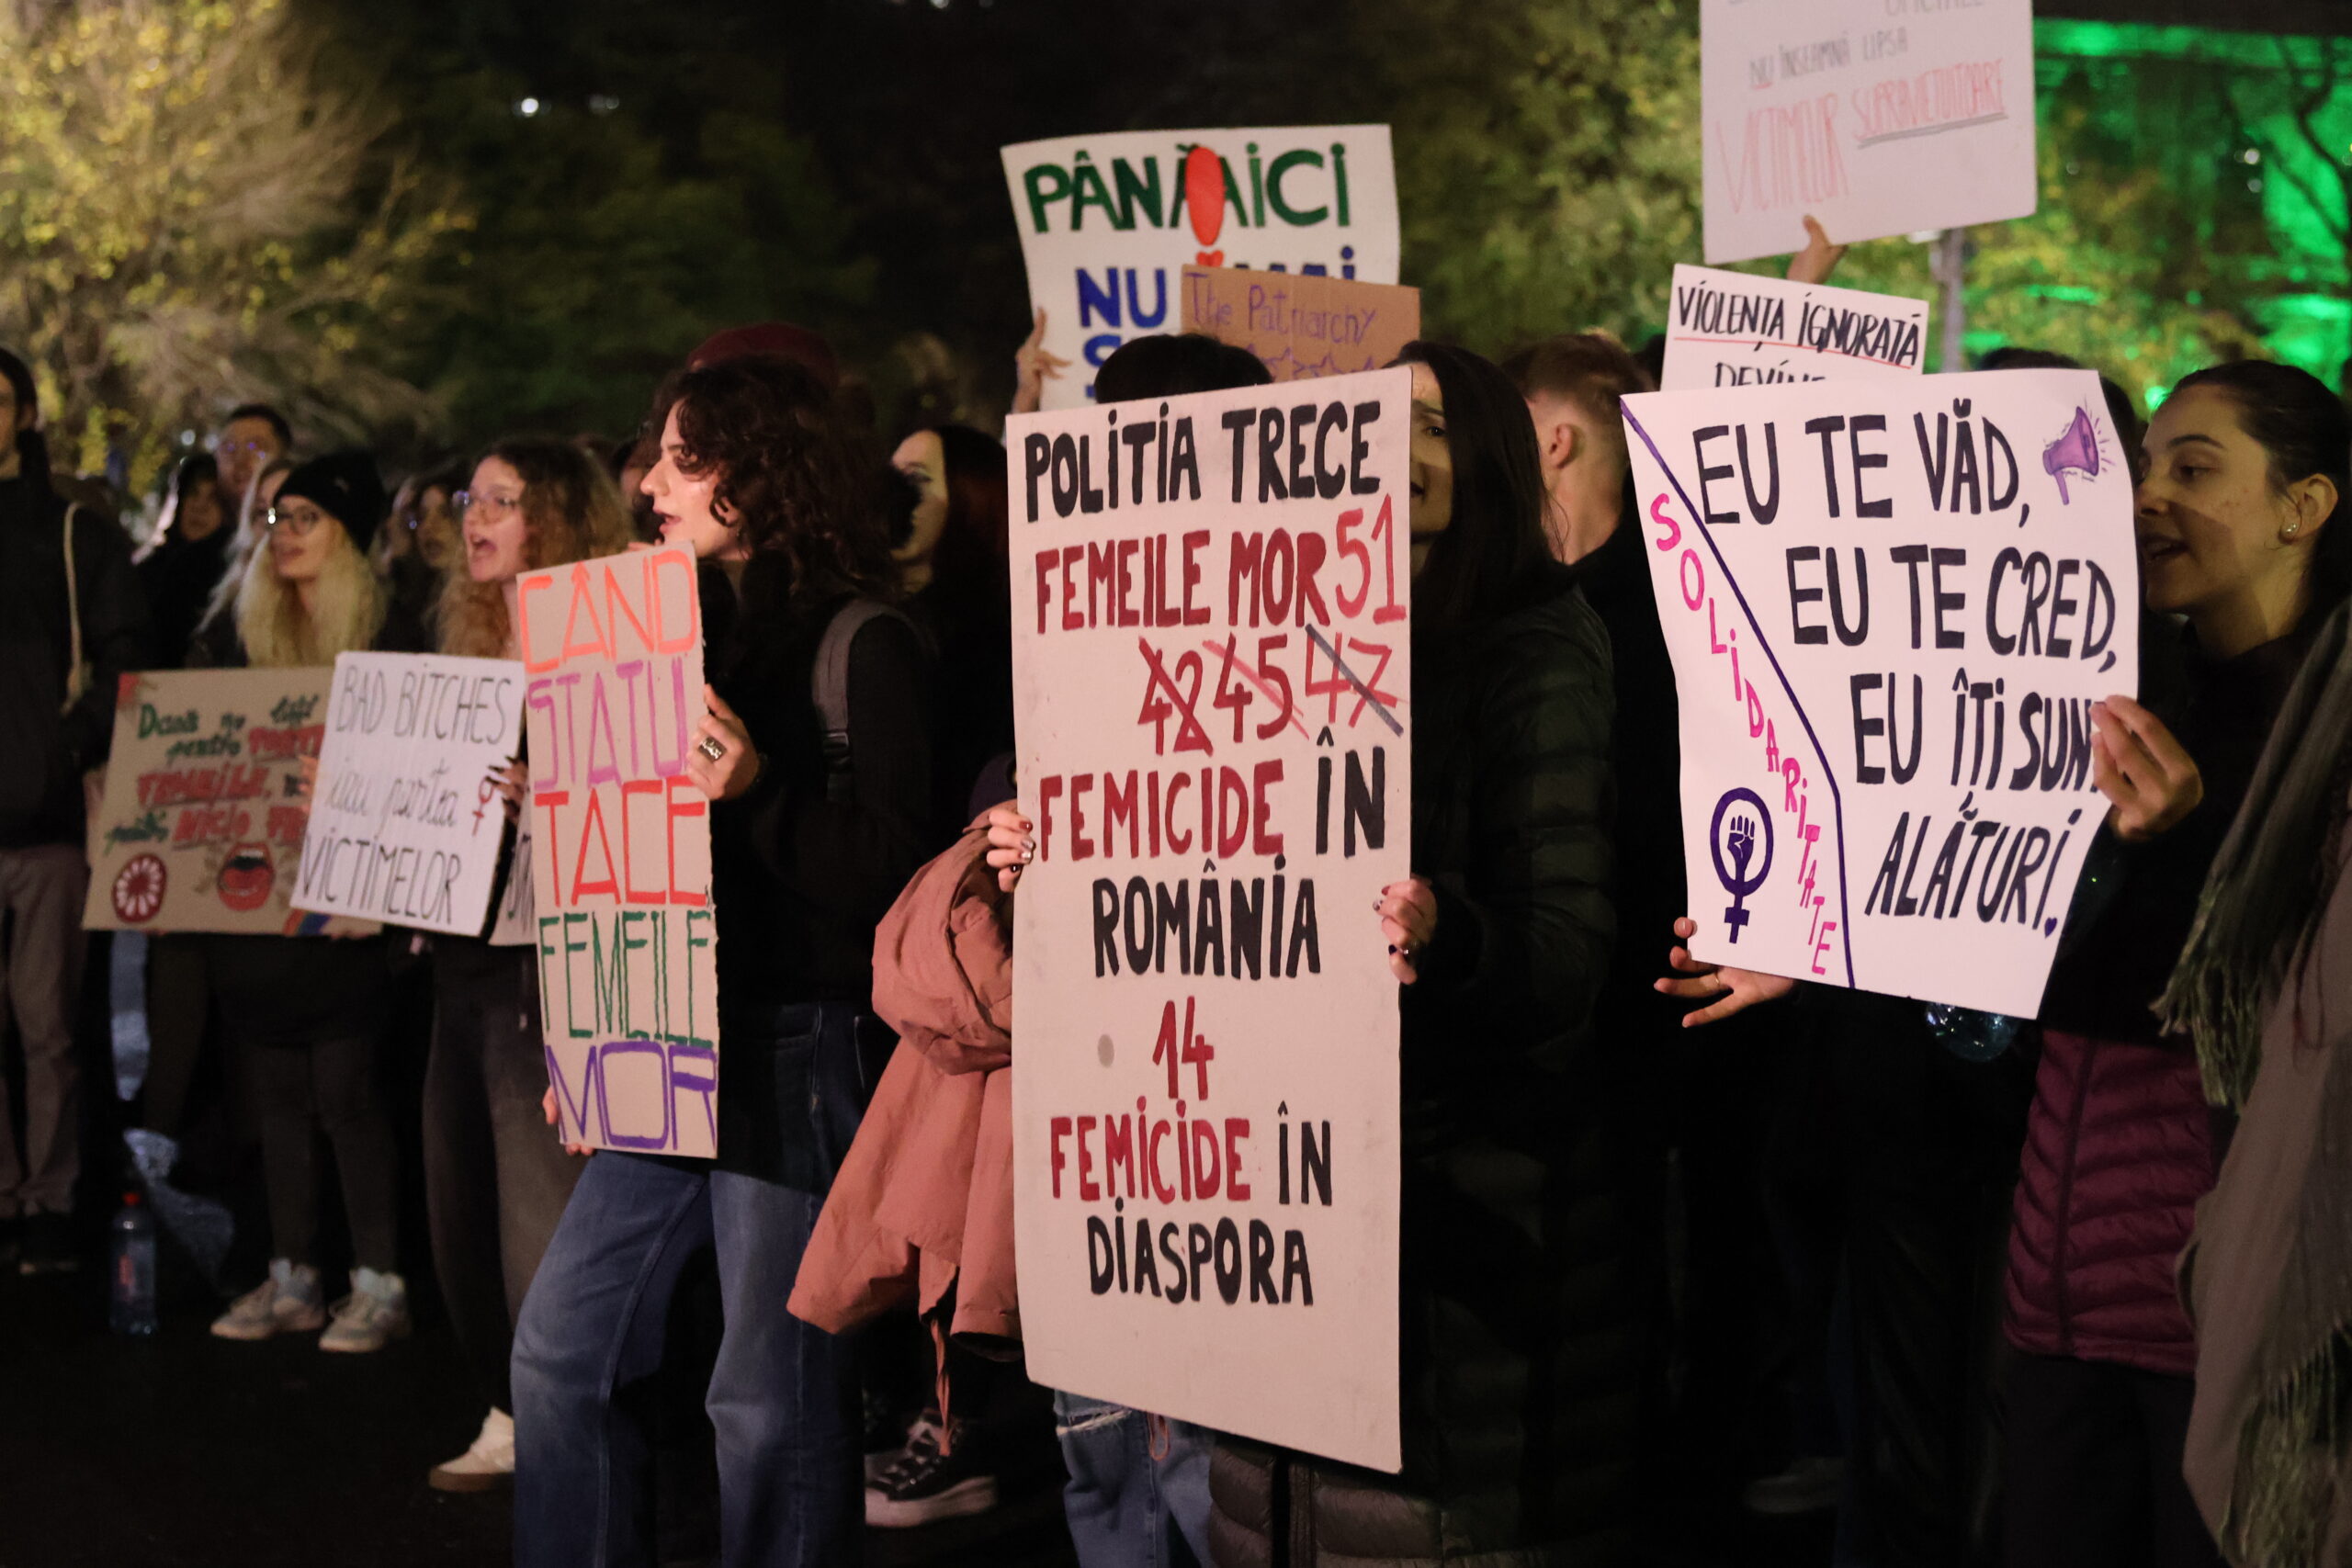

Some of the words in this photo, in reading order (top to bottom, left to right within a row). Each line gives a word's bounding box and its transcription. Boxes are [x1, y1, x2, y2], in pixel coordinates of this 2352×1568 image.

[1862, 27, 1908, 61] LIPSA
[1076, 266, 1168, 329] NU
[1185, 272, 1233, 327] The
[1248, 284, 1376, 345] Patriarchy
[1221, 400, 1382, 503] TRECE
[1692, 422, 1781, 525] EU
[1804, 414, 1893, 519] TE
[1912, 397, 2031, 529] VĂD,
[1035, 529, 1211, 635] FEMEILE
[1227, 527, 1331, 628] MOR
[1335, 493, 1408, 626] 51
[1785, 545, 1870, 648] EU
[1889, 544, 1967, 650] TE
[1984, 546, 2118, 673] CRED,
[334, 664, 387, 734] BAD
[392, 661, 512, 746] BITCHES
[1649, 492, 1838, 976] SOLIDARITATE
[1849, 671, 1923, 785] EU
[2008, 690, 2099, 794] SUN
[534, 774, 708, 908] TACE
[1039, 759, 1284, 862] FEMICIDE
[1315, 725, 1385, 859] ÎN
[301, 826, 462, 926] VICTIMELOR
[1091, 853, 1321, 981] ROMÂNIA
[538, 909, 715, 1049] FEMEILE
[544, 1040, 718, 1152] MOR
[1152, 995, 1215, 1101] 14
[1050, 1095, 1251, 1204] FEMICIDE
[1277, 1100, 1332, 1206] ÎN
[1086, 1195, 1314, 1307] DIASPORA
